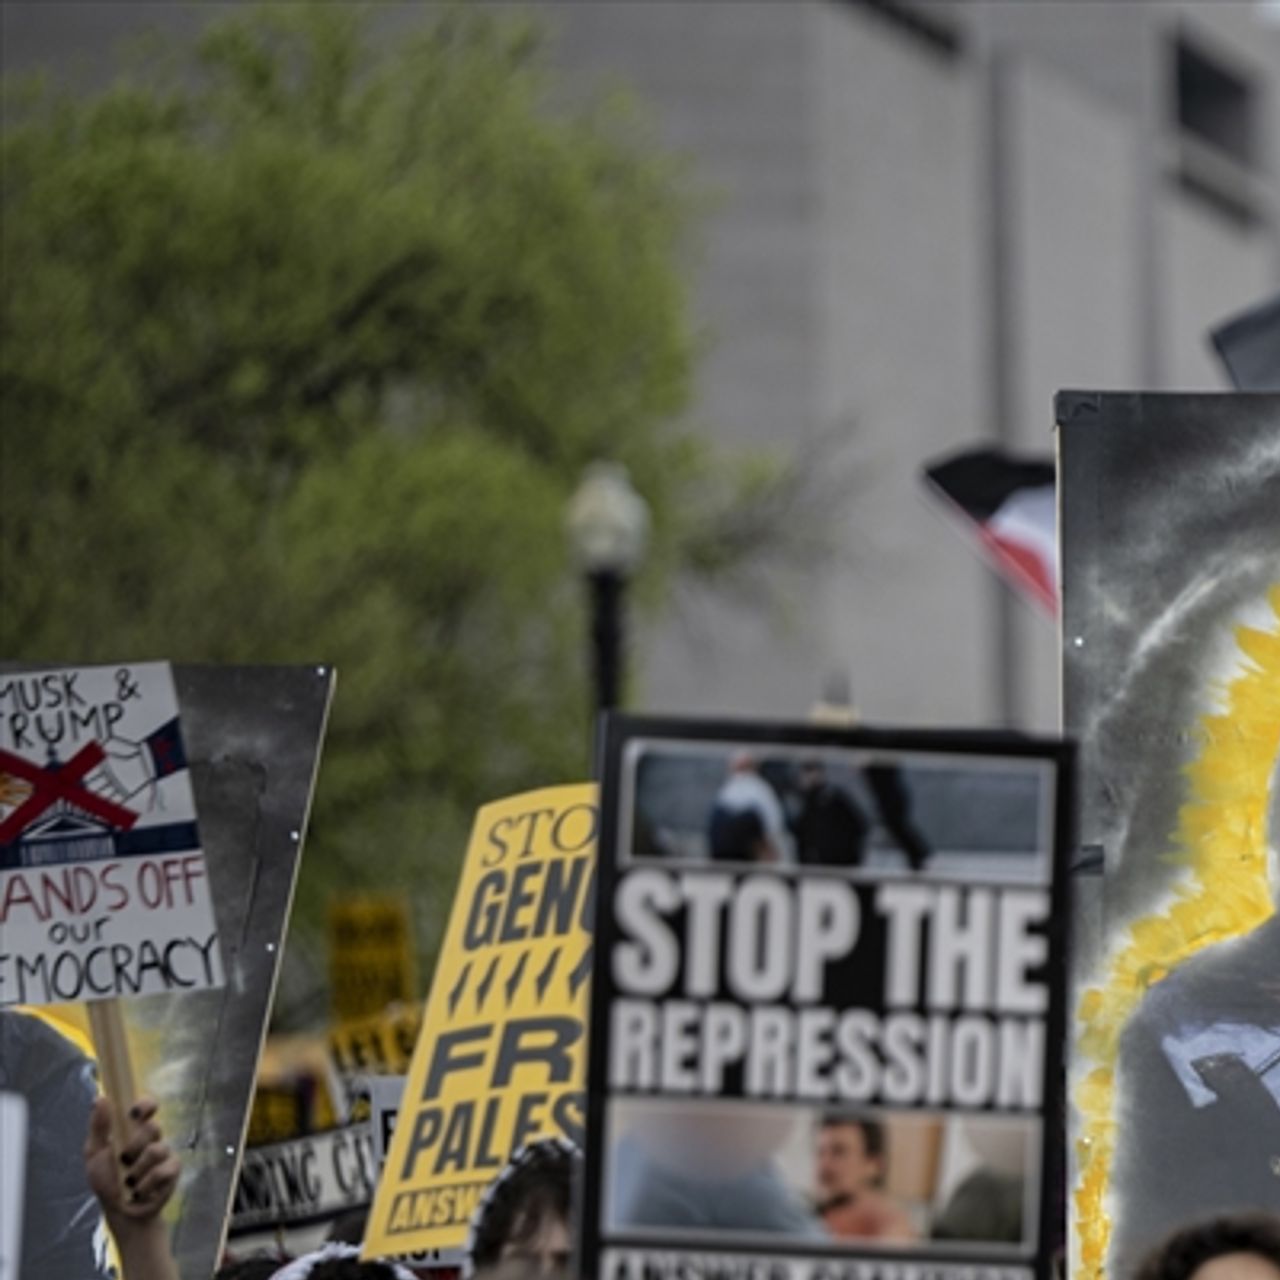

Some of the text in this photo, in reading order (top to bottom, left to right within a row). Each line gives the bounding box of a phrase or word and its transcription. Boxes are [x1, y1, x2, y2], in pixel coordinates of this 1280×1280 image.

[114, 667, 142, 701] &
[0, 702, 126, 749] RUMP
[137, 854, 205, 910] OFF
[611, 868, 1051, 1013] STOP THE
[608, 1000, 1048, 1109] REPRESSION
